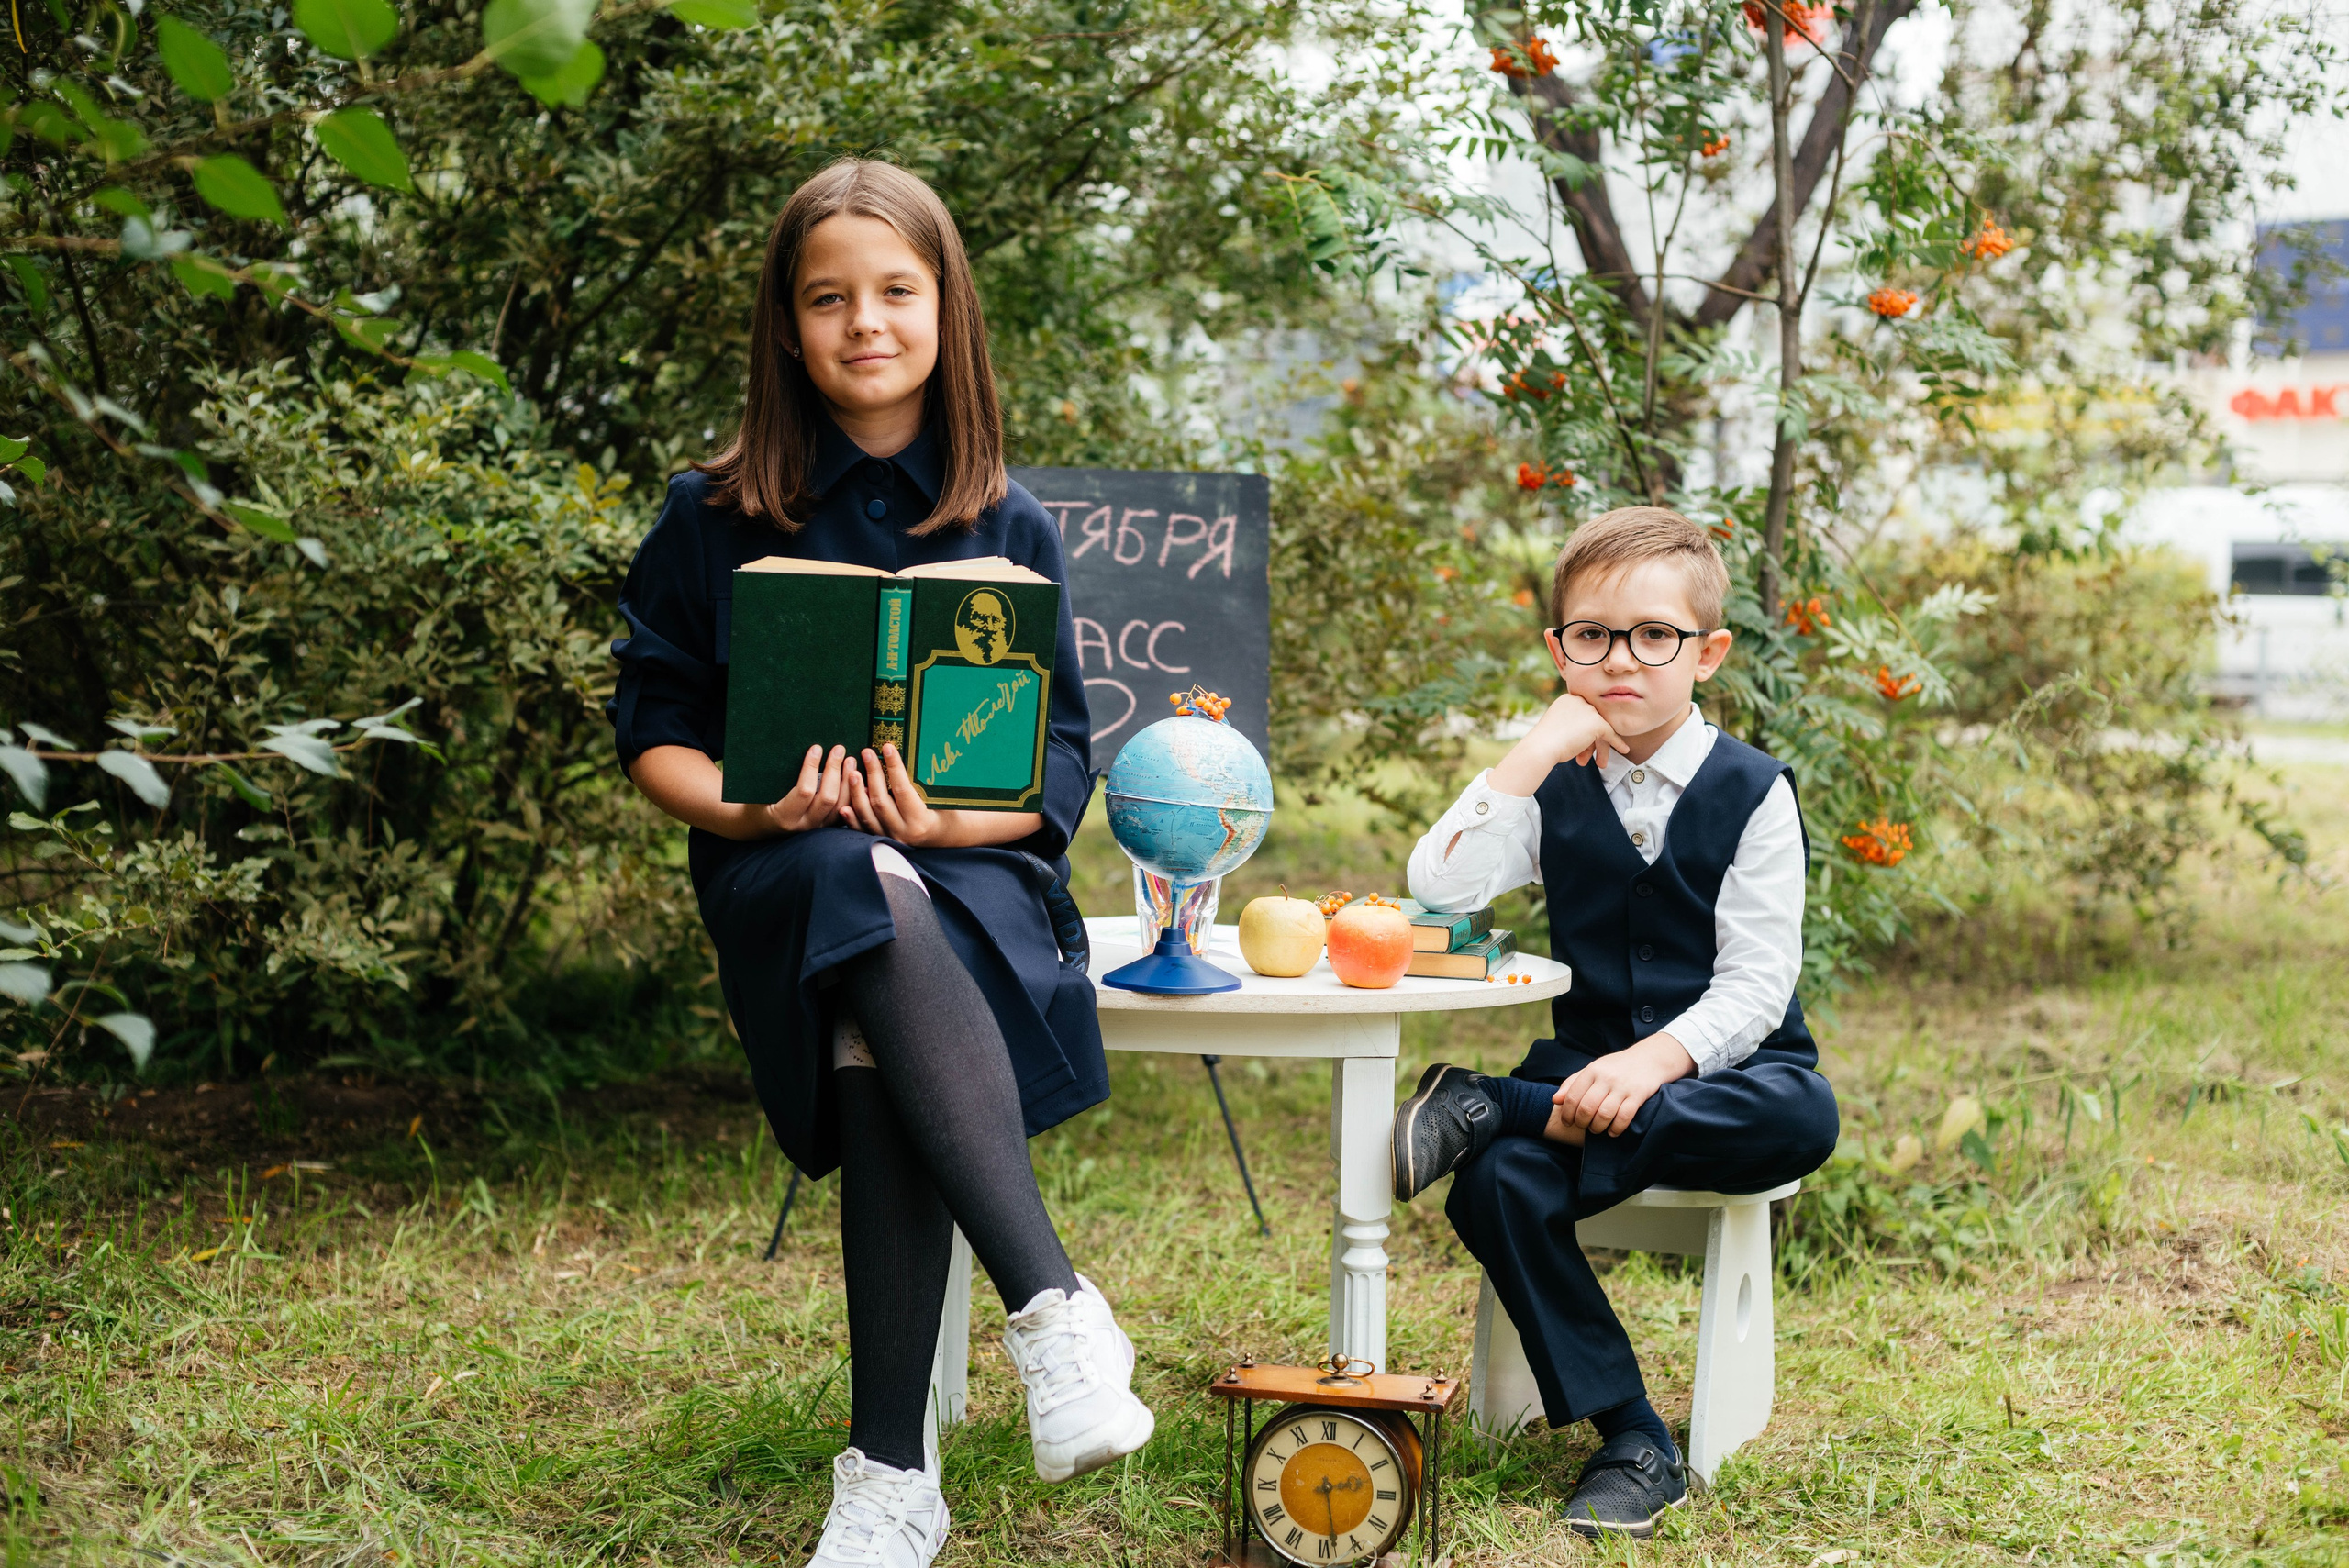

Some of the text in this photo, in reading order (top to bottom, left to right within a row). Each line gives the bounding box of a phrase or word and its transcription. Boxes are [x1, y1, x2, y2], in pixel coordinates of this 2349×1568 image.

[2230, 385, 2349, 421] ФАК
[1290, 1425, 1309, 1447] XI
[1321, 1420, 1338, 1441] XII
[1266, 1447, 1286, 1464] X
[1370, 1458, 1389, 1472] II
[1257, 1477, 1277, 1492] IX
[1376, 1489, 1397, 1501] III
[1262, 1503, 1286, 1526] VIII
[1368, 1514, 1388, 1534] IV
[1285, 1526, 1304, 1550] VII
[1318, 1539, 1331, 1559] VI
